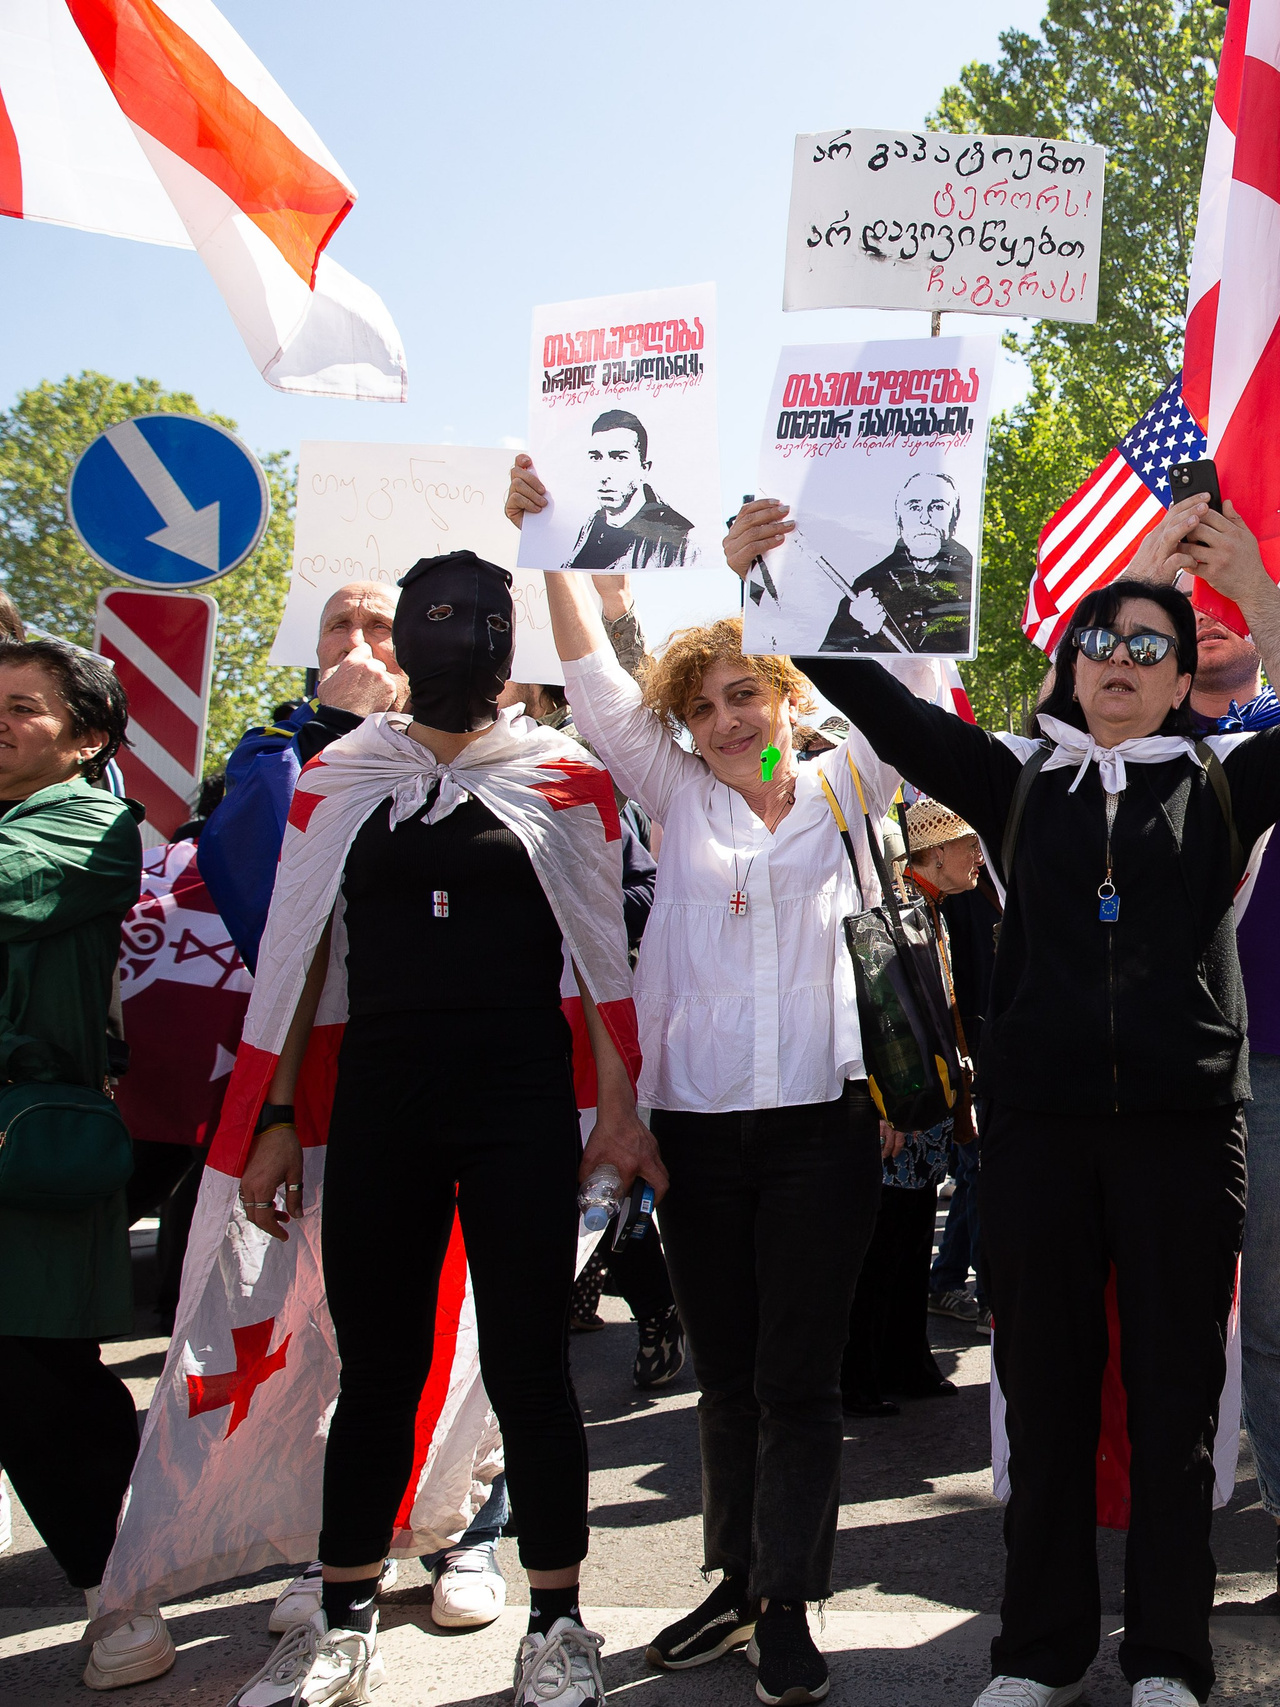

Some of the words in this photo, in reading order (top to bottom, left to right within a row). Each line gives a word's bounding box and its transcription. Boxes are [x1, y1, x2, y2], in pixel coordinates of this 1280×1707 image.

[813, 130, 852, 163] არ
[867, 134, 1086, 180] გაპატიებთ
[933, 178, 1092, 221] ტერორს!
[806, 210, 851, 248] არ
[861, 220, 1086, 268] დავივიწყებთ
[927, 264, 1087, 307] ჩაგვრას!
[543, 317, 704, 368] თავისუფლება
[542, 364, 597, 394] არჩილ
[782, 367, 980, 407] თავისუფლება
[776, 409, 854, 439] თემურ
